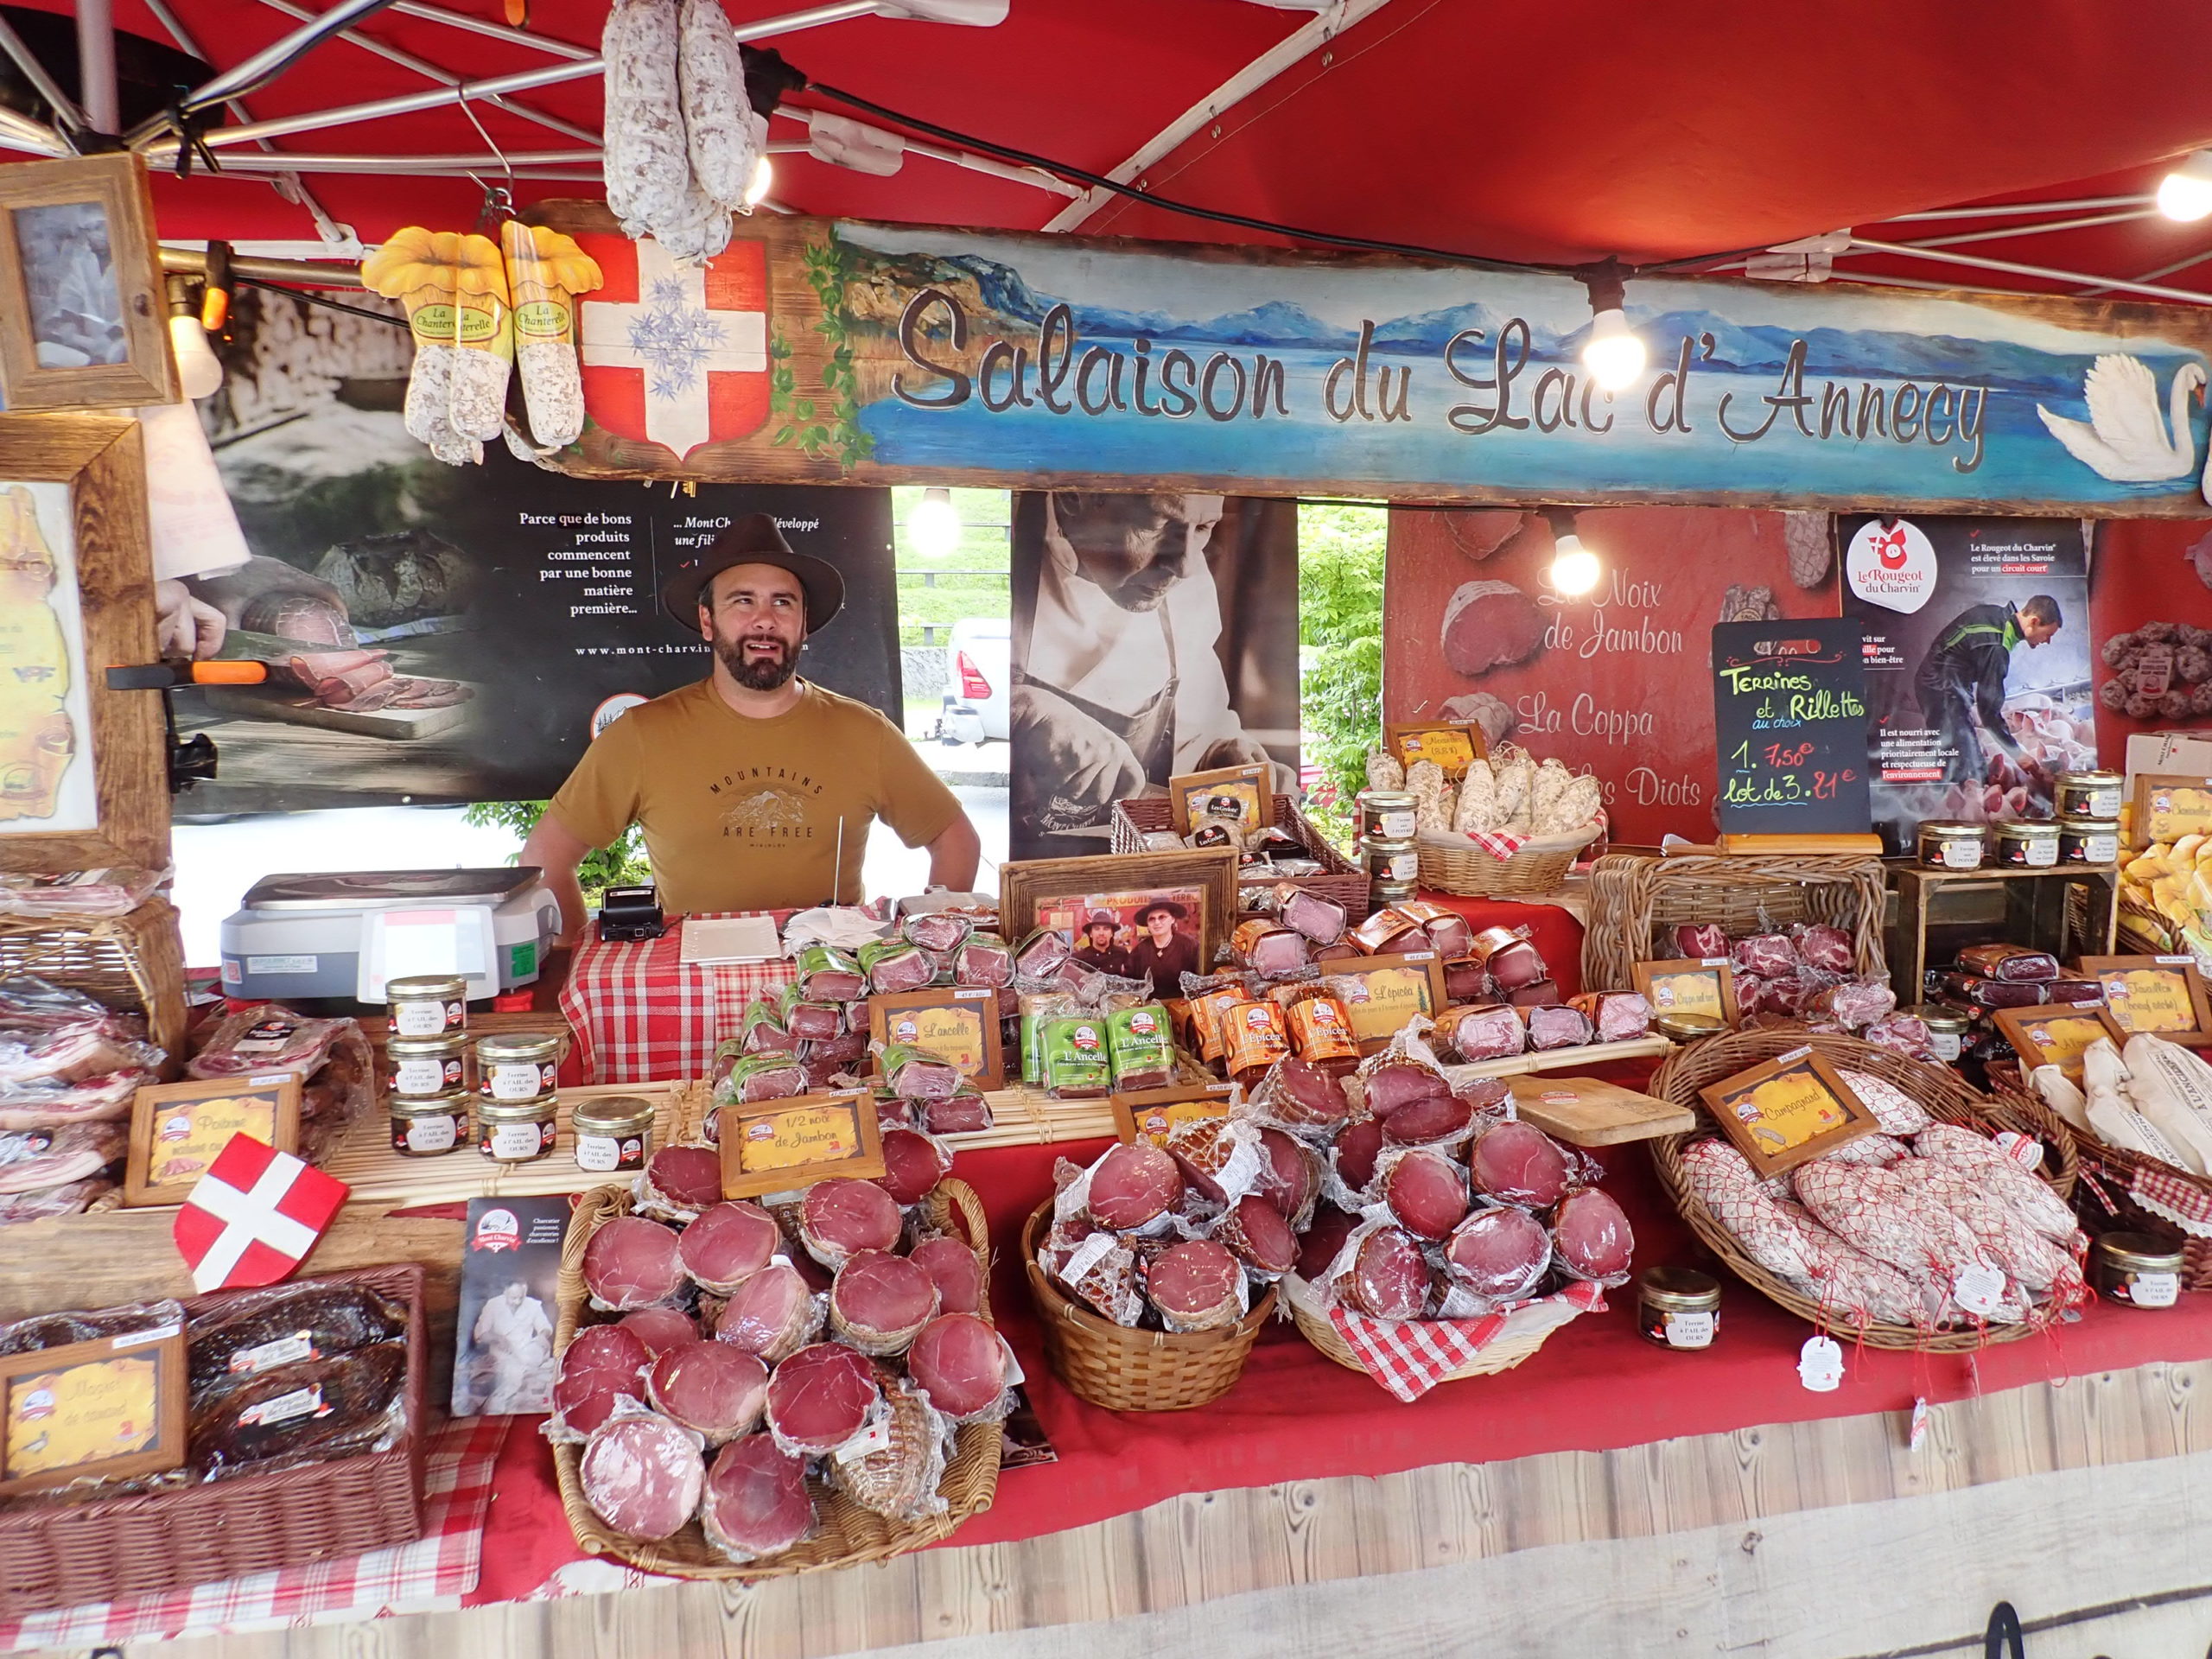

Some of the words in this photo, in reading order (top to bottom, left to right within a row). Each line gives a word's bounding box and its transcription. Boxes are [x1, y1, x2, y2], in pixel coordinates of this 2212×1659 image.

[433, 308, 446, 318] La
[537, 306, 549, 315] La
[891, 288, 1292, 422] Salaison
[1323, 319, 1413, 423] du
[1445, 317, 1614, 435] Lac
[519, 513, 556, 525] Parce
[558, 515, 582, 529] que
[584, 513, 599, 525] de
[601, 513, 632, 525] bons
[685, 517, 714, 529] Mont
[575, 531, 630, 545] produits
[675, 537, 695, 546] une
[548, 549, 631, 561] commencent
[1981, 544, 2012, 554] Rougeot
[540, 569, 563, 582] par
[565, 569, 589, 578] une
[592, 566, 632, 578] bonne
[1868, 569, 1923, 583] Rougeot
[1972, 566, 1989, 575] pour
[2002, 564, 2025, 573] circuit
[584, 584, 632, 596] matière
[1591, 568, 1662, 608] Noix
[1866, 583, 1878, 594] du
[570, 602, 638, 618] première...
[1544, 623, 1573, 651] de
[1580, 609, 1682, 658] Jambon
[1877, 646, 1895, 655] pour
[1757, 697, 1774, 718] et
[1790, 690, 1865, 721] Rillettes
[1516, 691, 1560, 734] La
[1572, 692, 1653, 745] Coppa
[1752, 720, 1770, 730] au
[1774, 715, 1802, 728] choix
[710, 767, 823, 794] MOUNTAINS
[1625, 767, 1700, 805] Diots
[1724, 777, 1761, 803] lot
[1764, 778, 1783, 801] de
[723, 827, 754, 836] ARE
[771, 827, 812, 837] FREE
[1764, 1089, 1821, 1121] Campagnard
[787, 1116, 805, 1128] 1/2
[775, 1136, 789, 1147] de
[791, 1130, 836, 1147] Jambon
